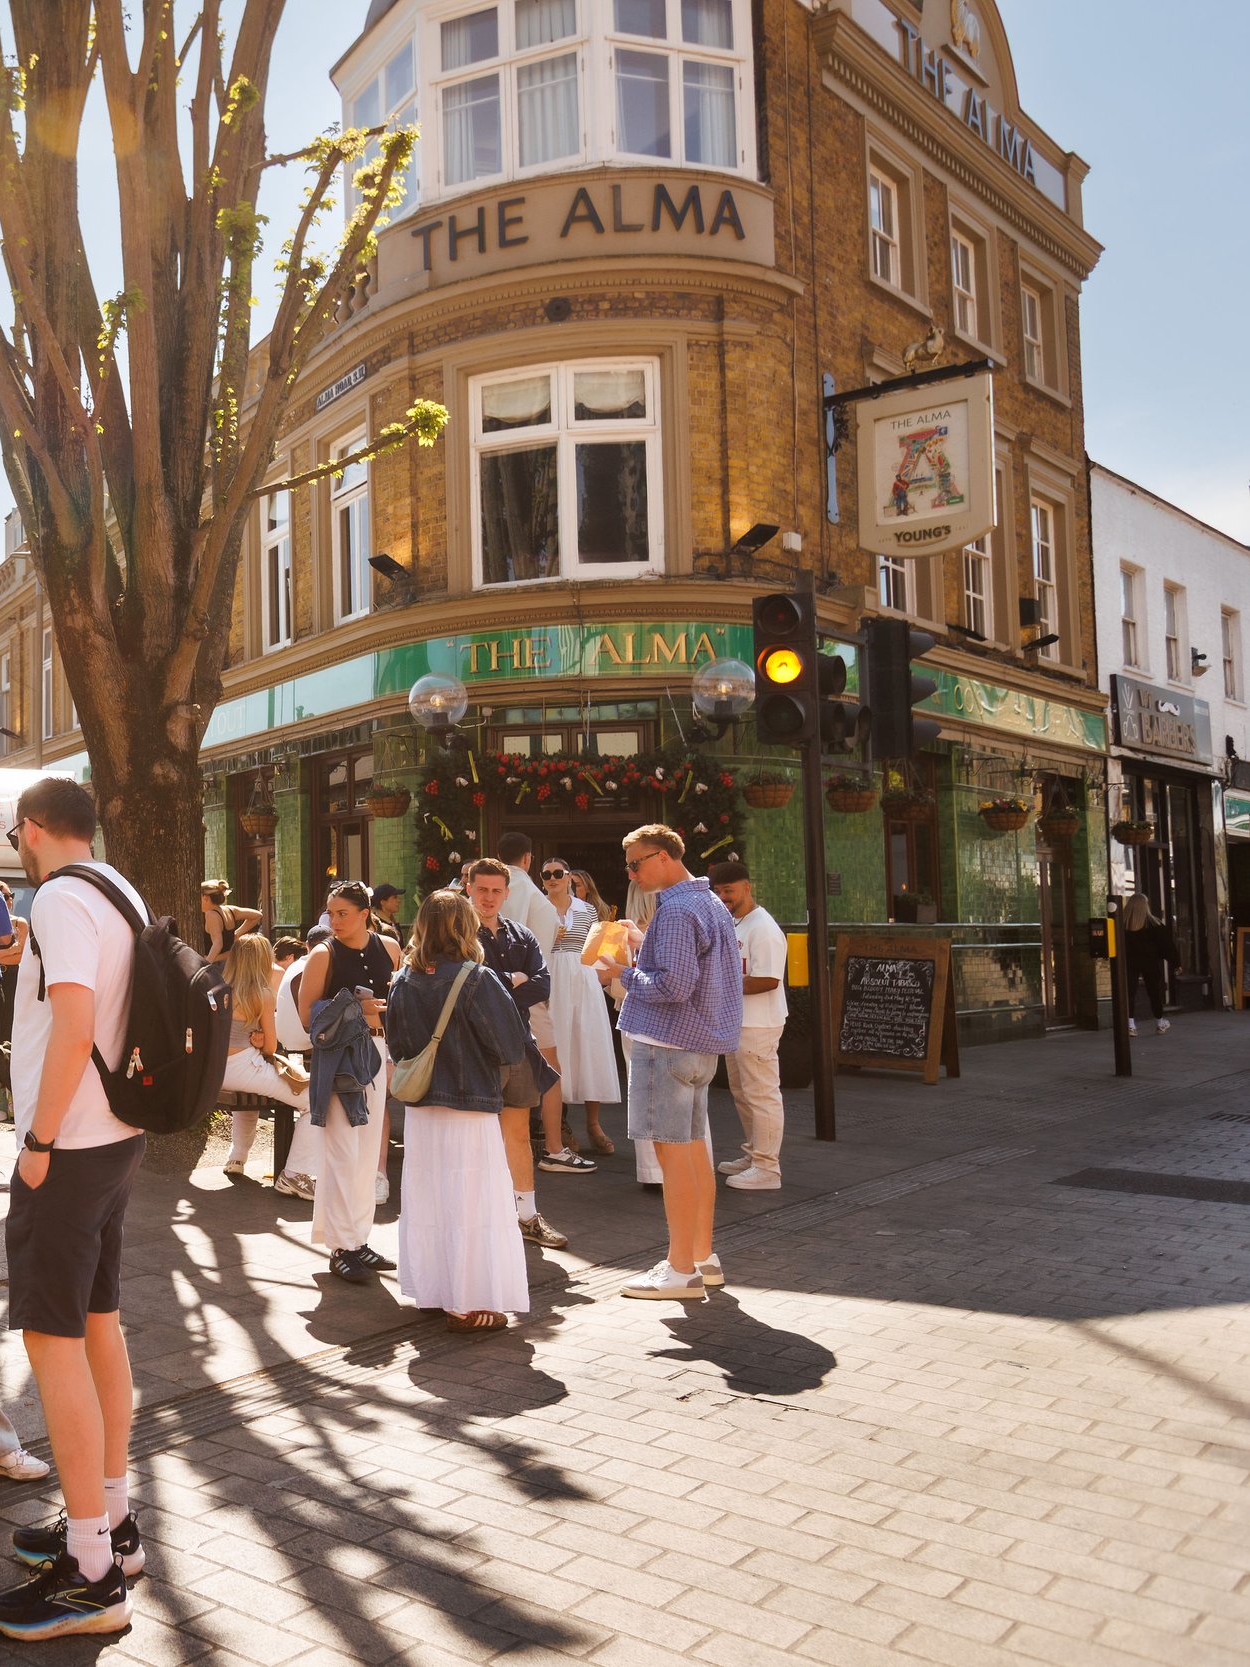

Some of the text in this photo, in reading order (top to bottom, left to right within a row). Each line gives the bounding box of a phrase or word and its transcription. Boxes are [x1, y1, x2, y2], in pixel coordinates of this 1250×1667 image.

[411, 184, 745, 271] THE ALMA
[890, 410, 952, 430] THE ALMA
[894, 525, 952, 543] YOUNG'S
